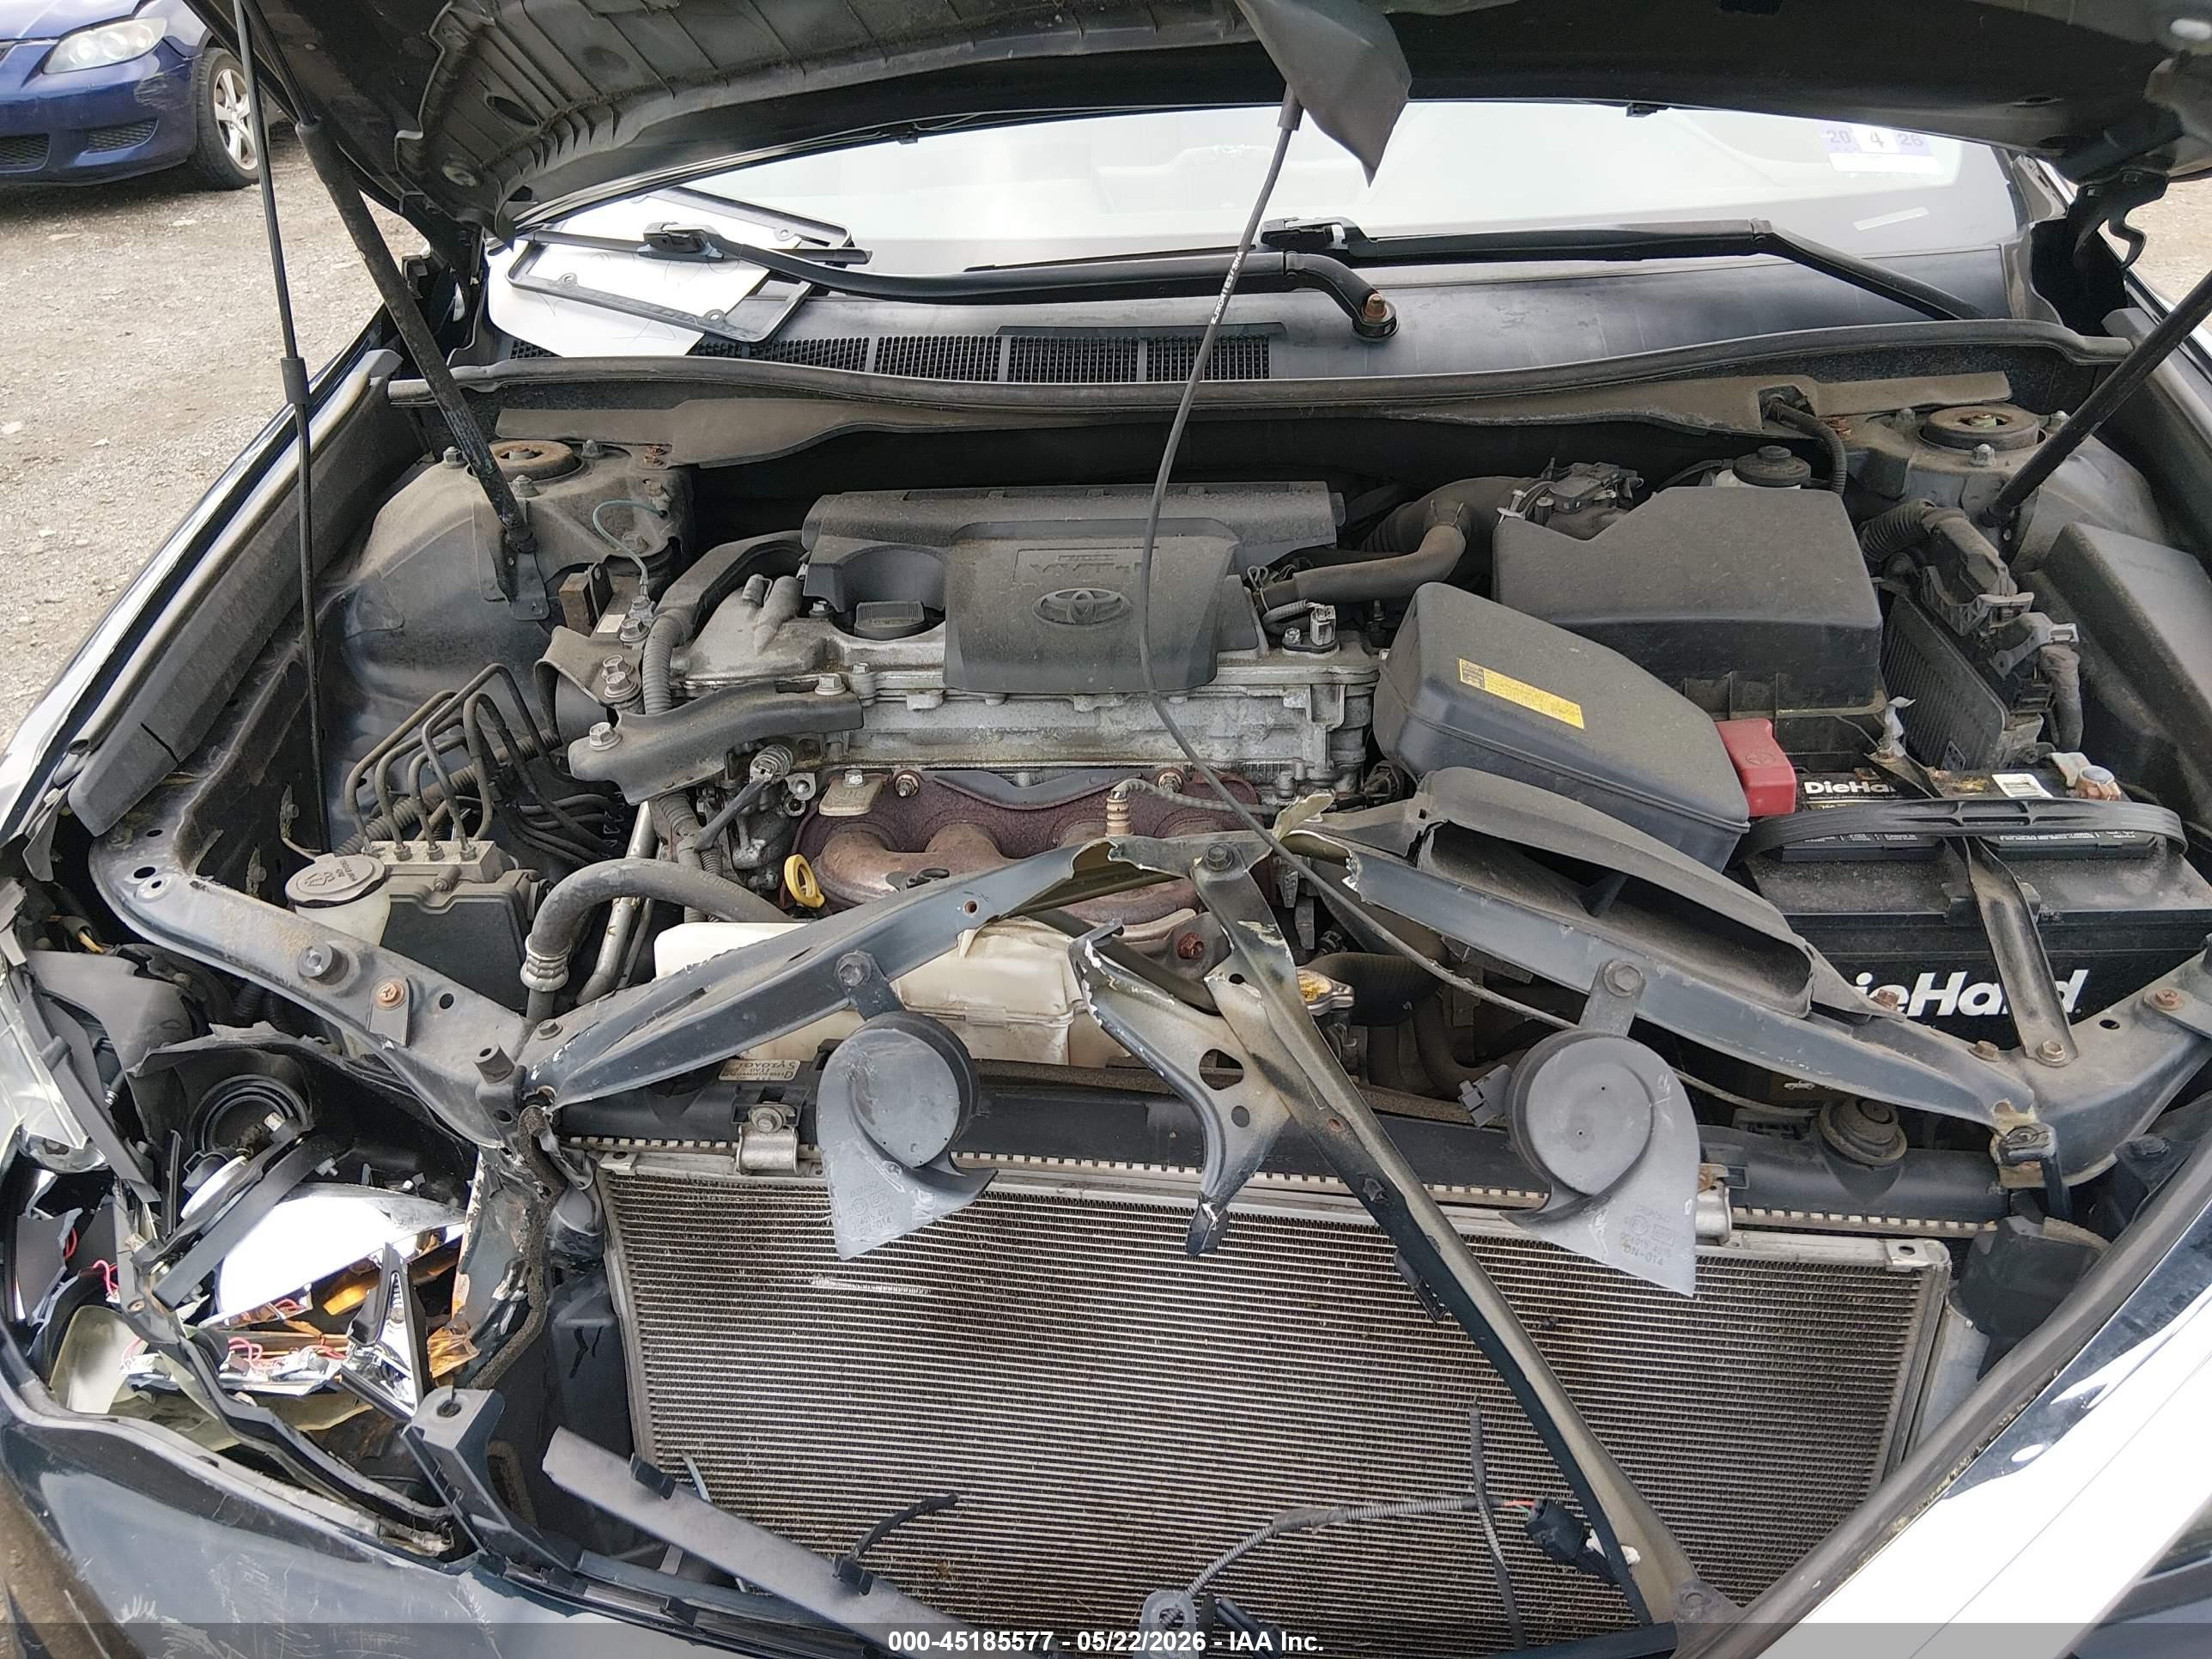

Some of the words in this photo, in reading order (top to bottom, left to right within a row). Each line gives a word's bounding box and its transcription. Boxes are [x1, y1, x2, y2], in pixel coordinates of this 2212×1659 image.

[1826, 130, 1851, 144] 20
[1869, 132, 1885, 148] 4
[1897, 133, 1924, 147] 26
[1804, 781, 1897, 794] DieHa
[1855, 969, 2089, 1017] ieHad
